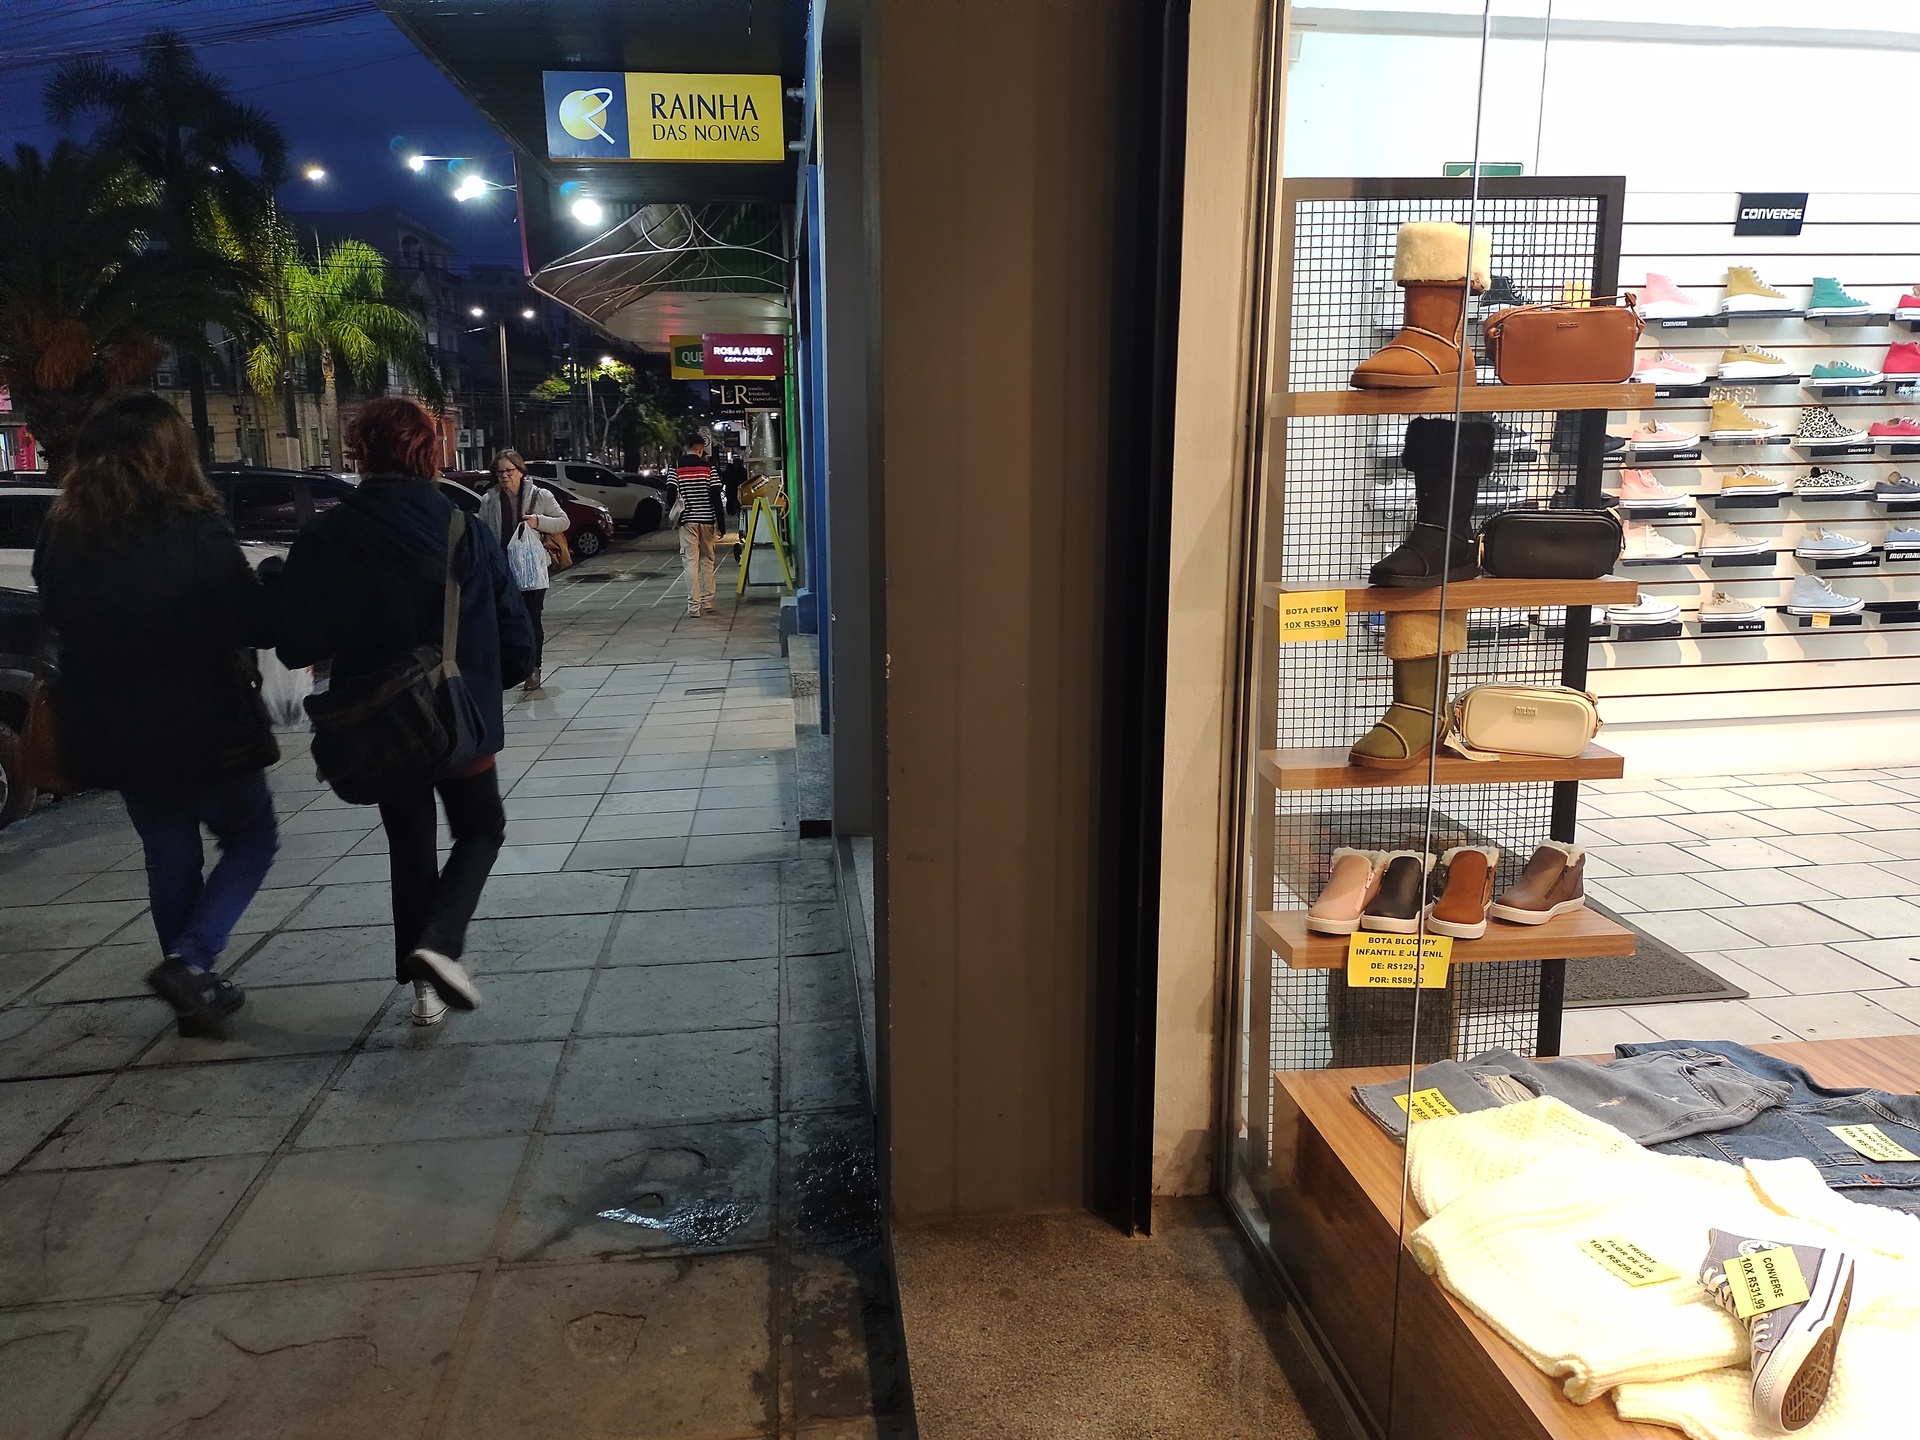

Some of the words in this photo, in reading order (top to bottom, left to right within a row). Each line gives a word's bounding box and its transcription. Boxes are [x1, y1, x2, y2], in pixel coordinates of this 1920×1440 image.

[650, 93, 759, 121] RAINHA
[652, 124, 687, 141] DAS
[694, 124, 760, 142] NOIVAS
[1741, 208, 1803, 220] CONVERSE
[713, 346, 741, 356] ROSA
[742, 347, 773, 356] AREIA
[1284, 621, 1301, 629] 10X
[1406, 950, 1443, 958] JUENIL
[1420, 1096, 1433, 1109] FLOR
[1590, 1239, 1608, 1254] 10X
[1628, 1244, 1657, 1264] TRICOT
[1607, 1240, 1628, 1256] FLOR
[1627, 1256, 1640, 1264] DE
[1639, 1264, 1654, 1273] LIS
[1742, 1258, 1755, 1275] 10X
[1763, 1257, 1784, 1298] CONVERSE
